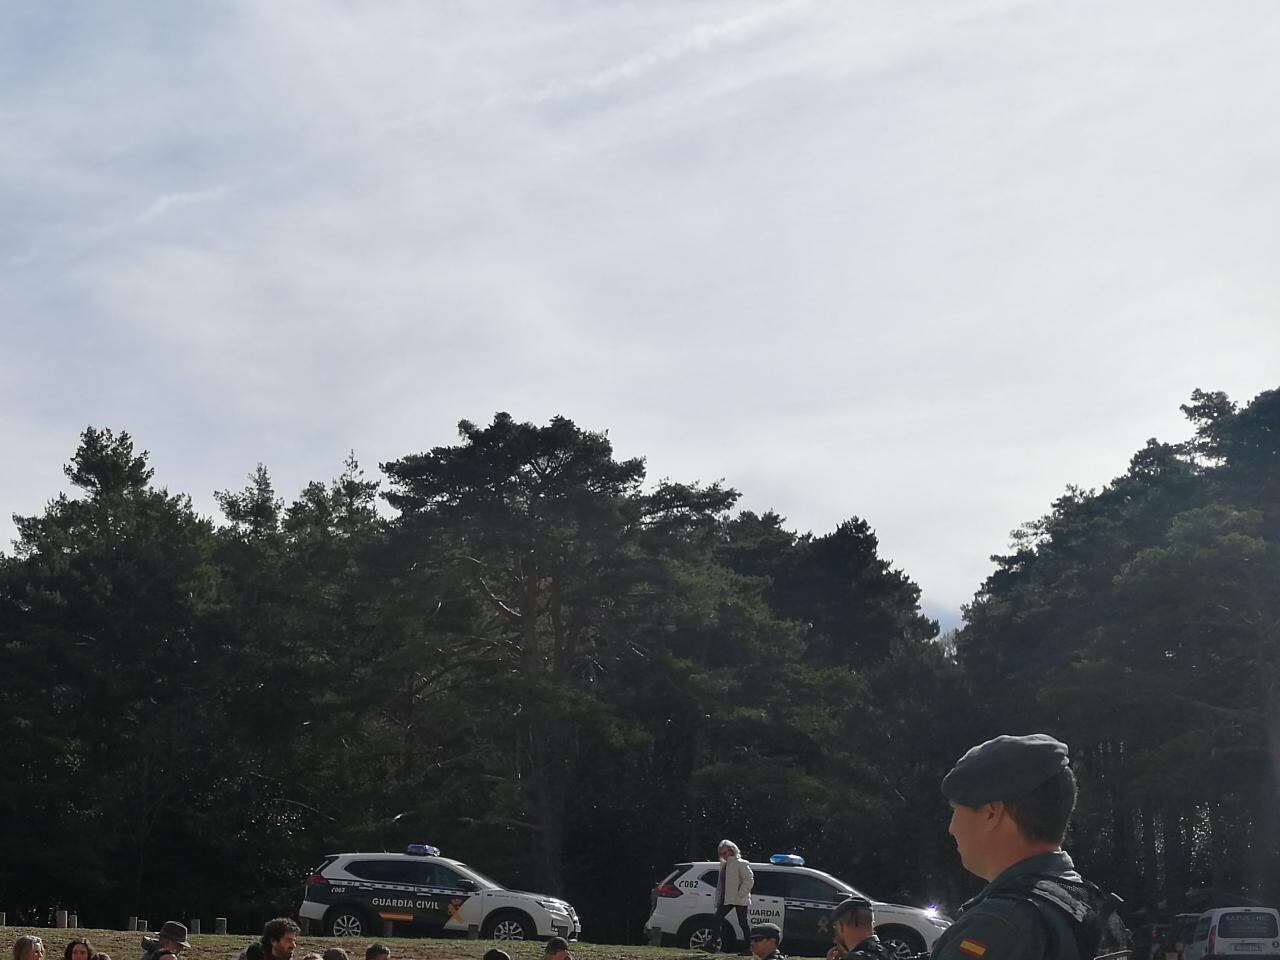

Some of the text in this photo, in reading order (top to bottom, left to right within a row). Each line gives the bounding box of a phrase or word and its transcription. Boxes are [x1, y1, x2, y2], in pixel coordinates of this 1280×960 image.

[372, 898, 439, 910] GUARDIA CIVIL
[749, 909, 780, 917] UARDIA
